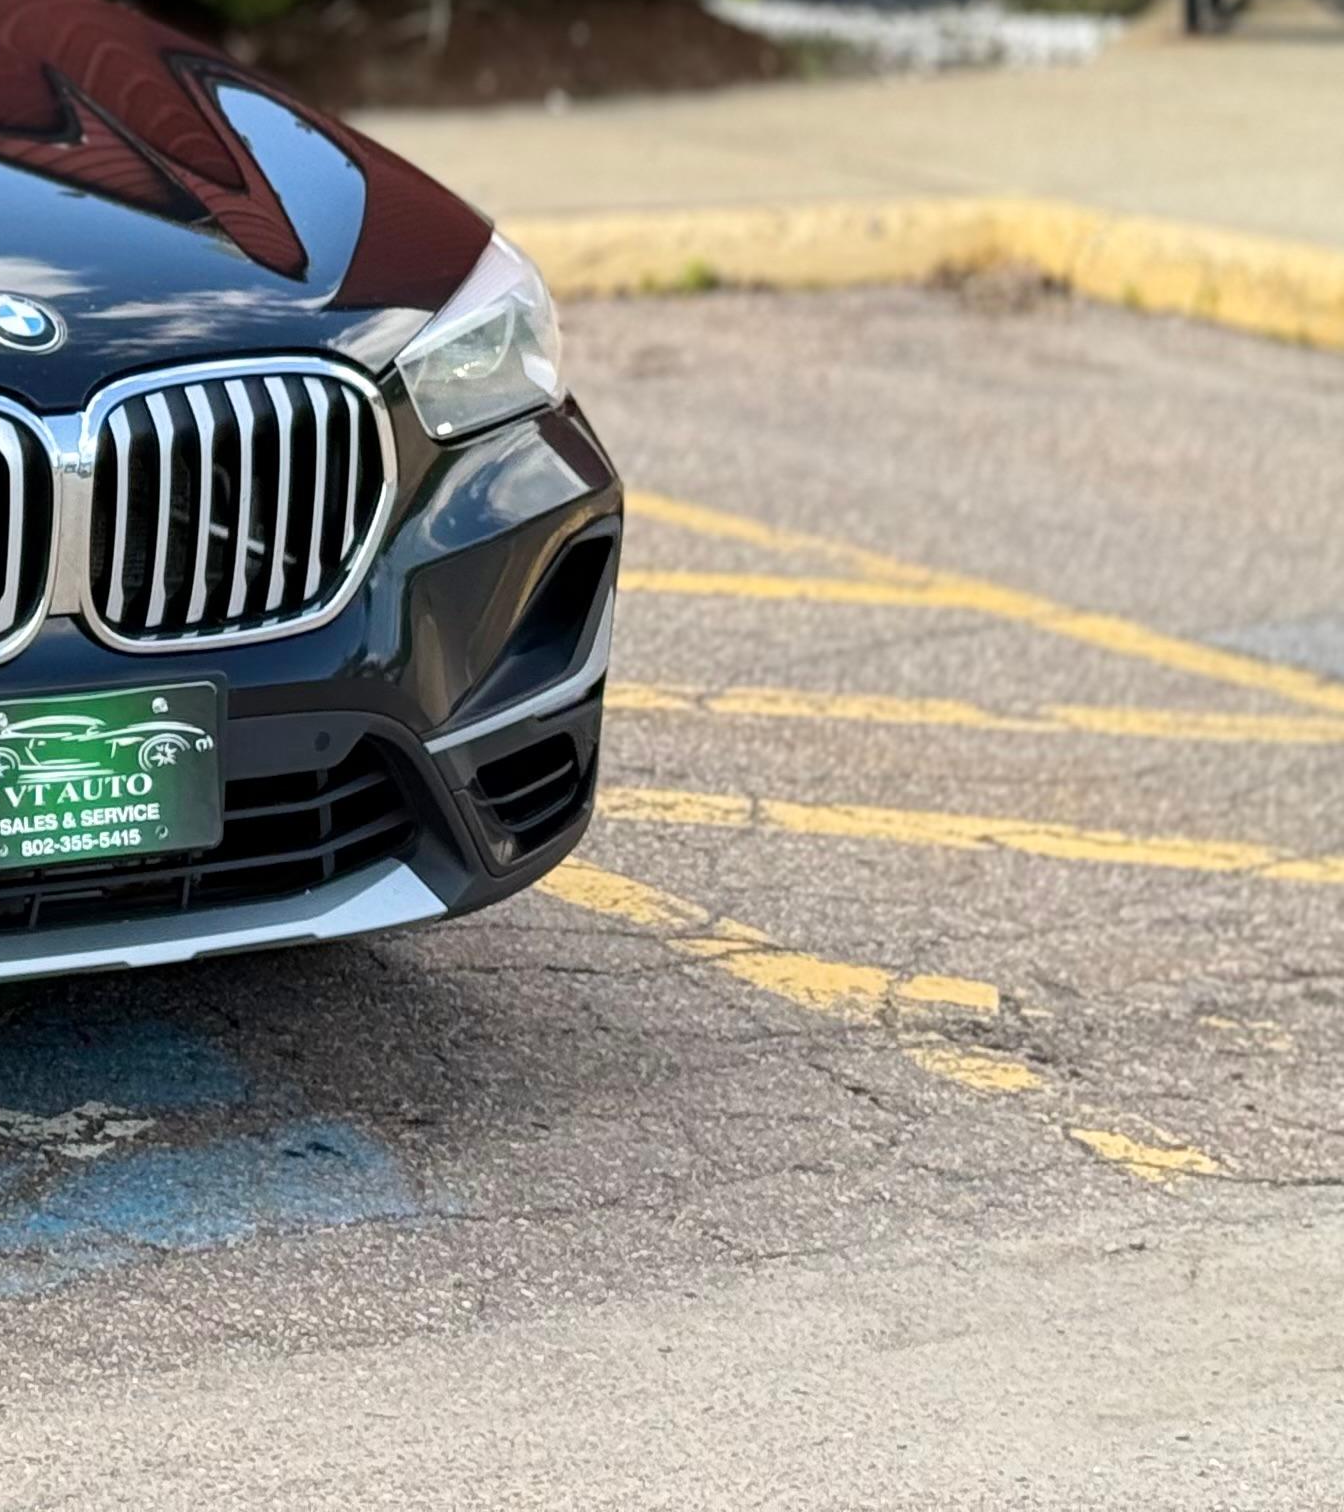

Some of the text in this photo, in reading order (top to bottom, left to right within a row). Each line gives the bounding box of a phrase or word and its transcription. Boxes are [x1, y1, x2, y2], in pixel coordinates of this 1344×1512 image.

[5, 773, 152, 808] VT AUTO
[0, 803, 160, 836] SALES & SERVICE
[22, 829, 141, 856] 802-355-5415
